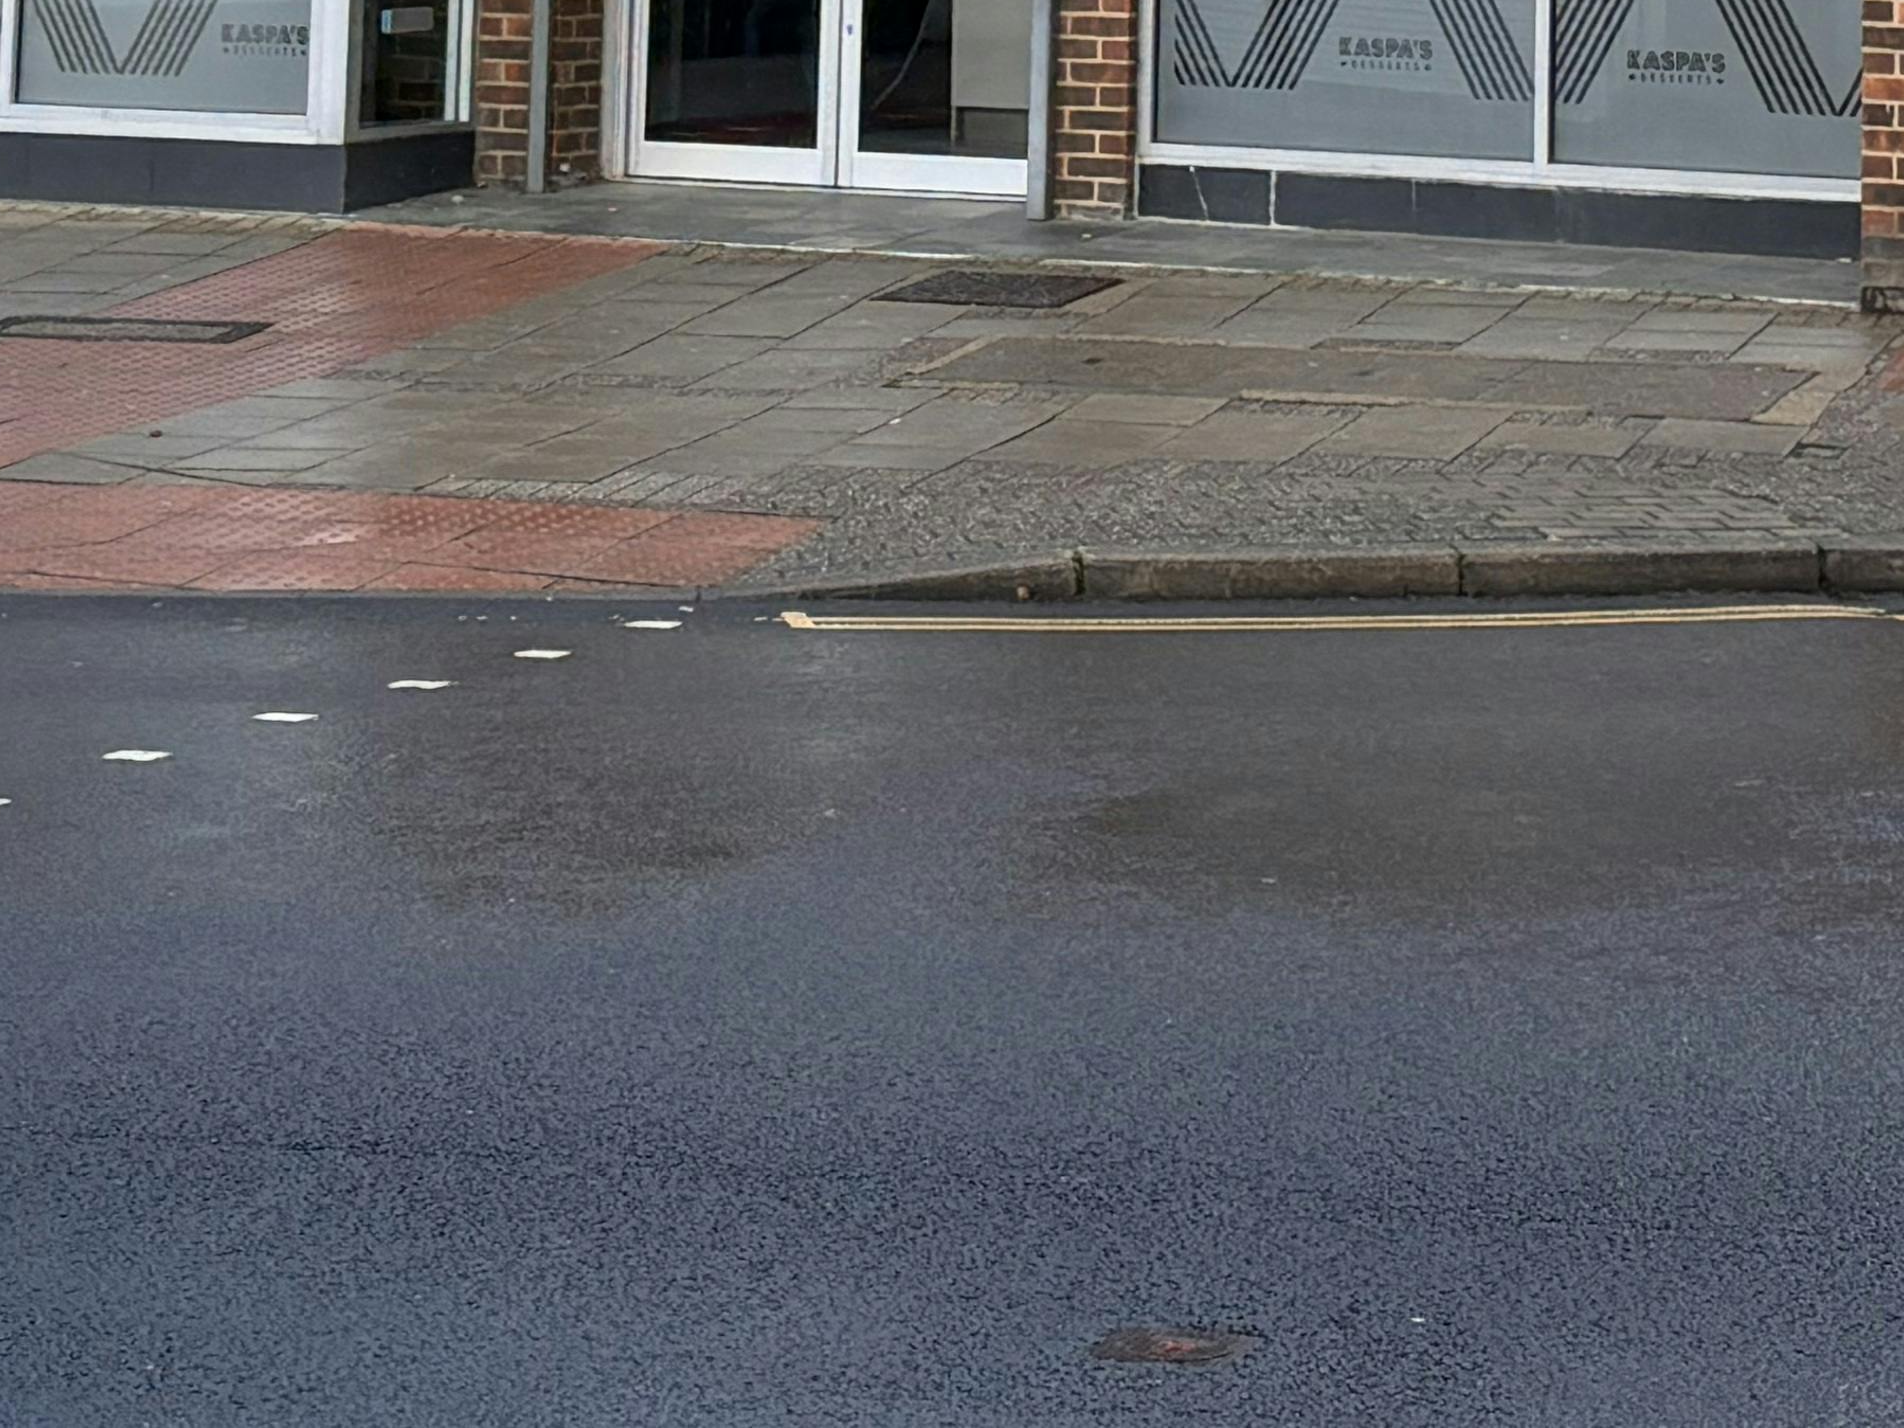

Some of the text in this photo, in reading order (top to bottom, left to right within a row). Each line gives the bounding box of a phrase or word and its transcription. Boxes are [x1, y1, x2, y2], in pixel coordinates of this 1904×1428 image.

[221, 23, 309, 45] KASPA'S
[1339, 37, 1433, 61] KASPA'S
[1627, 49, 1727, 74] KASPA'S
